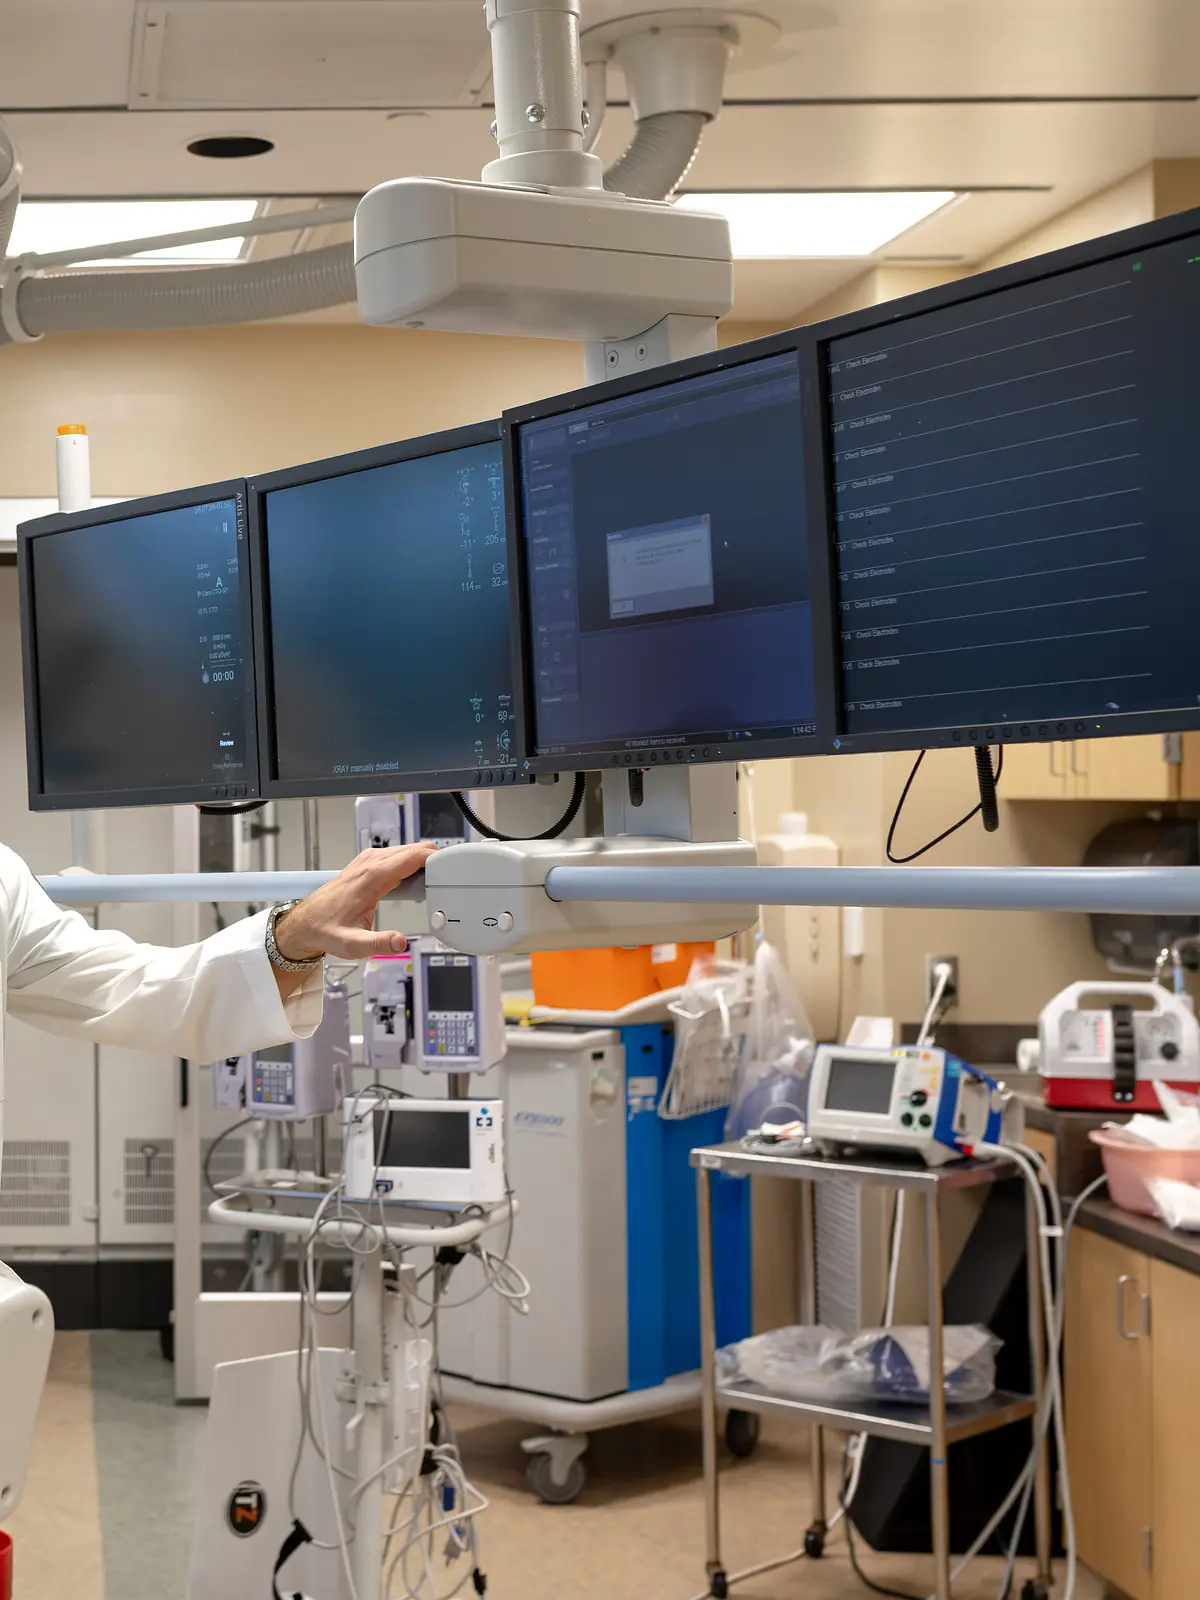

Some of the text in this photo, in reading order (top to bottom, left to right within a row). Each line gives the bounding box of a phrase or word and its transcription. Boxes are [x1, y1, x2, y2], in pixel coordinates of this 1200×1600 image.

[846, 360, 861, 369] Check
[862, 354, 888, 364] Electrodes
[840, 392, 855, 400] Check
[856, 386, 881, 396] Electrodes
[850, 419, 865, 428] Check
[866, 414, 891, 424] Electrodes
[845, 451, 860, 460] Check
[861, 446, 886, 456] Electrodes
[852, 480, 867, 489] Check
[868, 475, 894, 485] Electrodes
[236, 492, 244, 517] Artis
[849, 510, 864, 519] Check
[865, 506, 891, 516] Electrodes
[484, 534, 499, 545] 205
[852, 541, 867, 549] Check
[868, 536, 894, 546] Electrodes
[853, 571, 868, 579] Check
[870, 567, 895, 577] Electrodes
[216, 577, 223, 587] A
[461, 581, 474, 592] 114
[491, 577, 501, 587] 32
[871, 597, 897, 606] Electrodes
[856, 631, 871, 639] Check
[872, 628, 899, 637] Electrodes
[858, 661, 873, 669] Check
[874, 658, 900, 667] Electrodes
[212, 671, 234, 682] 00:00
[860, 702, 875, 710] Check
[876, 700, 902, 708] Electrodes
[498, 710, 507, 720] 69
[333, 761, 399, 773] XRAY manually disabled
